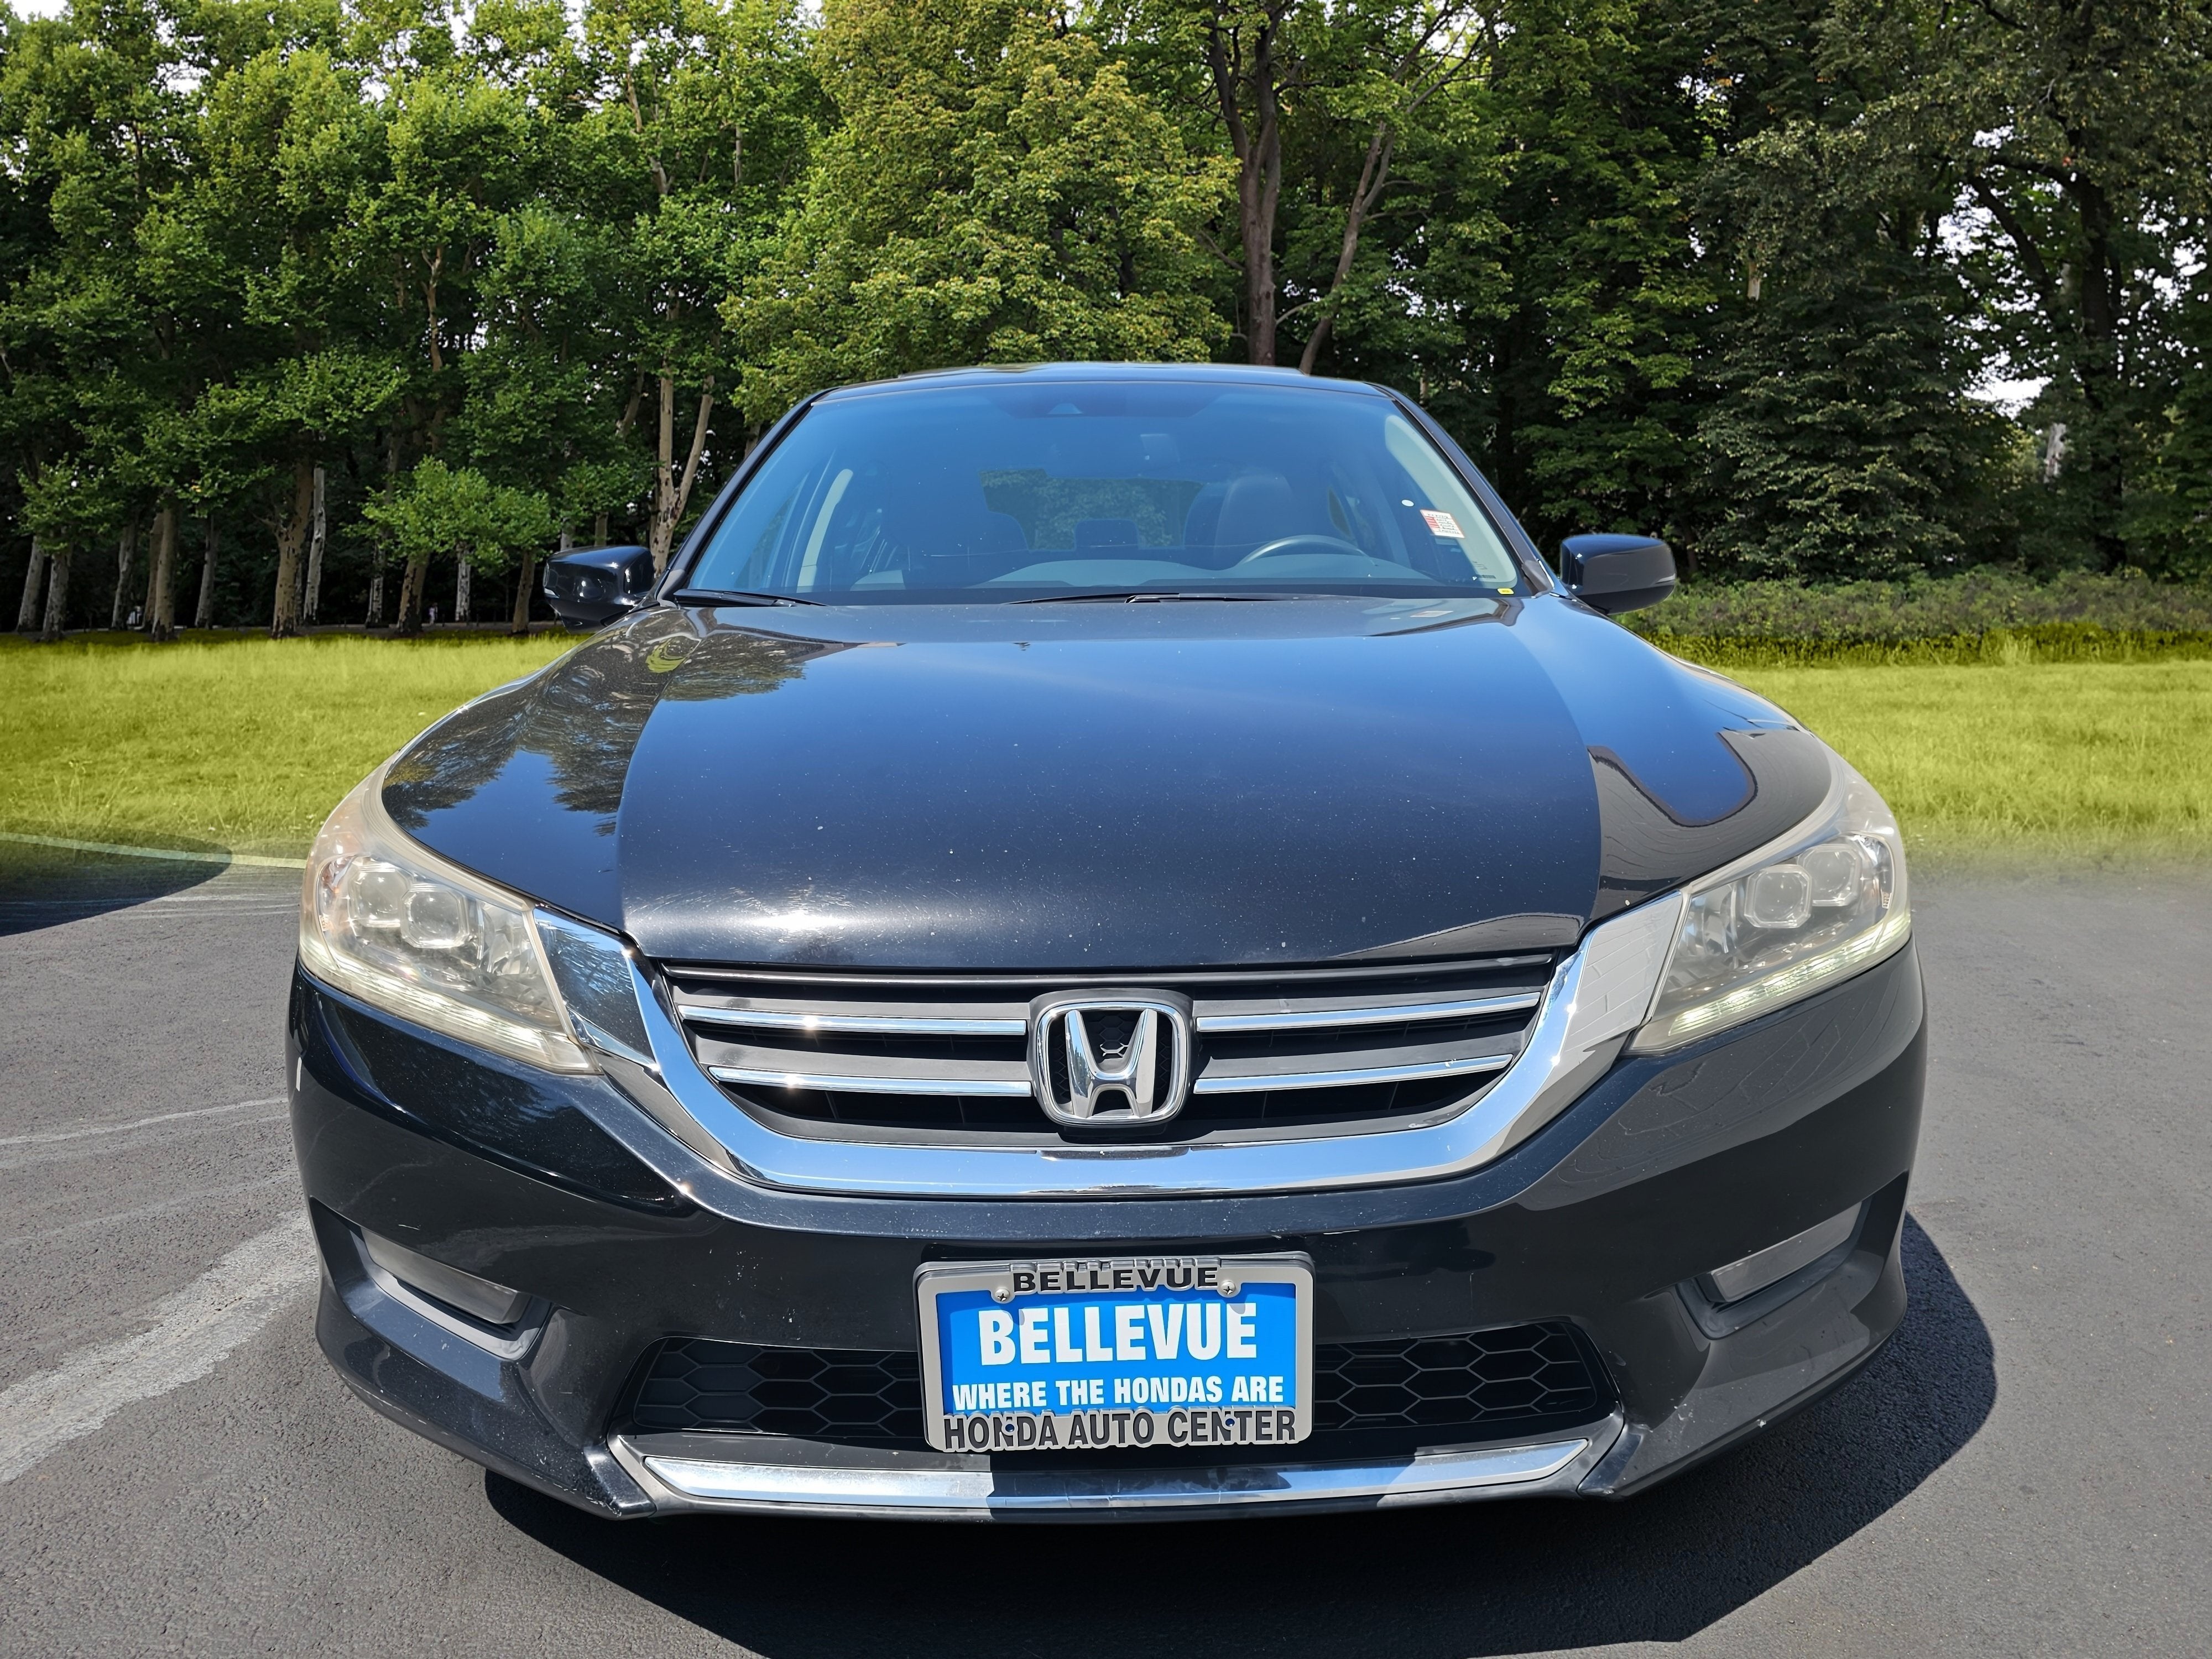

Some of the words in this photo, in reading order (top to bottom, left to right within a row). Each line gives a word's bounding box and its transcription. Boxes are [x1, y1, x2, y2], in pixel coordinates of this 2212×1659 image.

[1013, 1267, 1218, 1293] BELLEVUE
[978, 1302, 1257, 1366] BELLEVUE
[952, 1381, 1047, 1411] WHERE
[1055, 1379, 1104, 1406] THE
[1114, 1375, 1223, 1404] HONDAS
[1231, 1376, 1284, 1402] ARE
[943, 1415, 1059, 1449] HONDA
[1068, 1412, 1154, 1446] AUTO
[1167, 1410, 1296, 1444] CENTER
